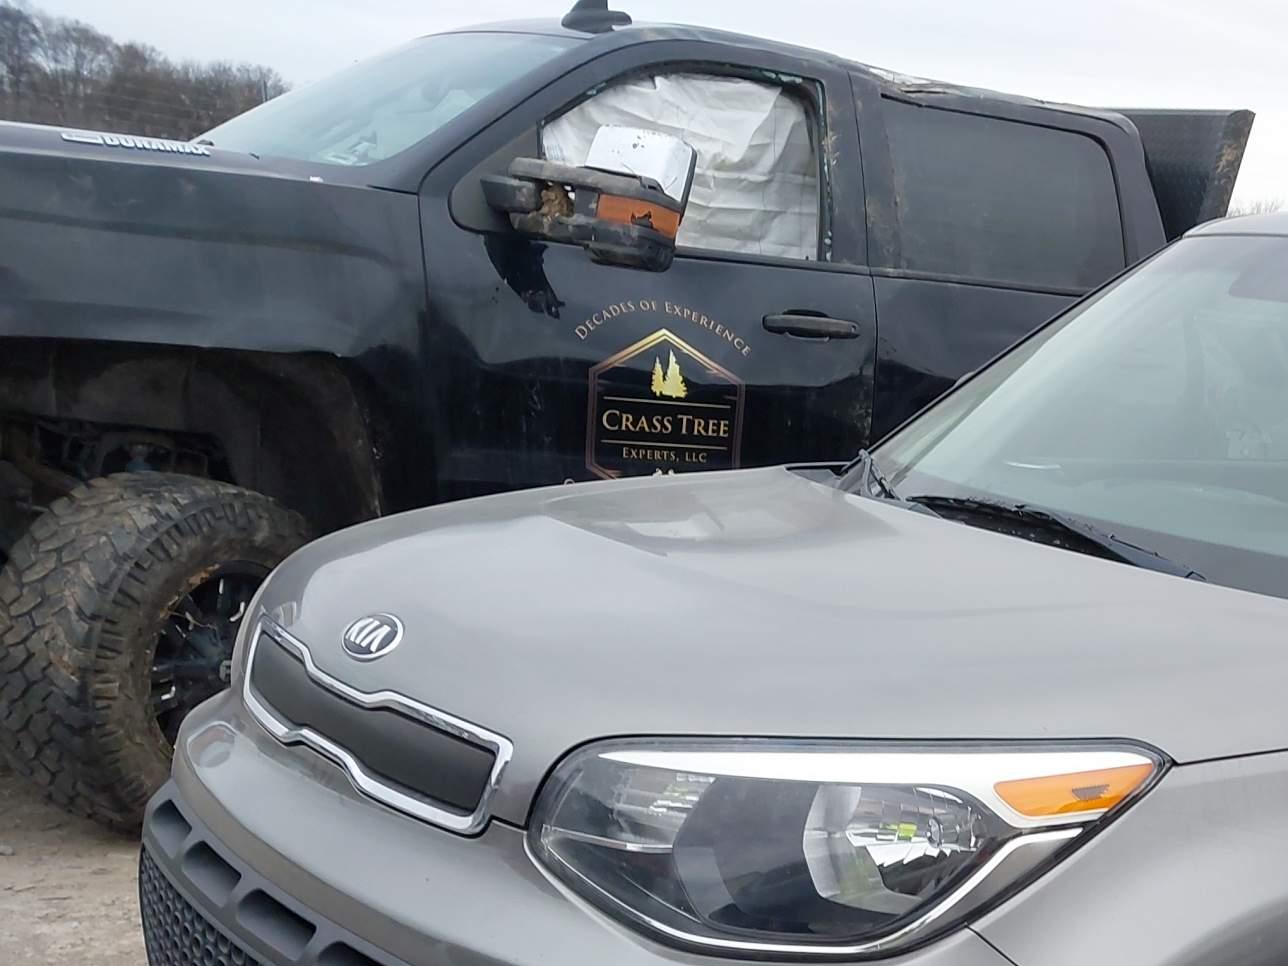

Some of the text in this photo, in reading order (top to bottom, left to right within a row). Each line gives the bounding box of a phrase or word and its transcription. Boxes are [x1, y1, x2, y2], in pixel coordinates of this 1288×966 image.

[102, 135, 211, 156] DURAMAX
[575, 299, 751, 357] DECADES OF EXPERIENCE
[602, 409, 729, 438] CRASS TREE
[622, 446, 707, 463] EXPERTS, LLC
[344, 617, 392, 653] KIA
